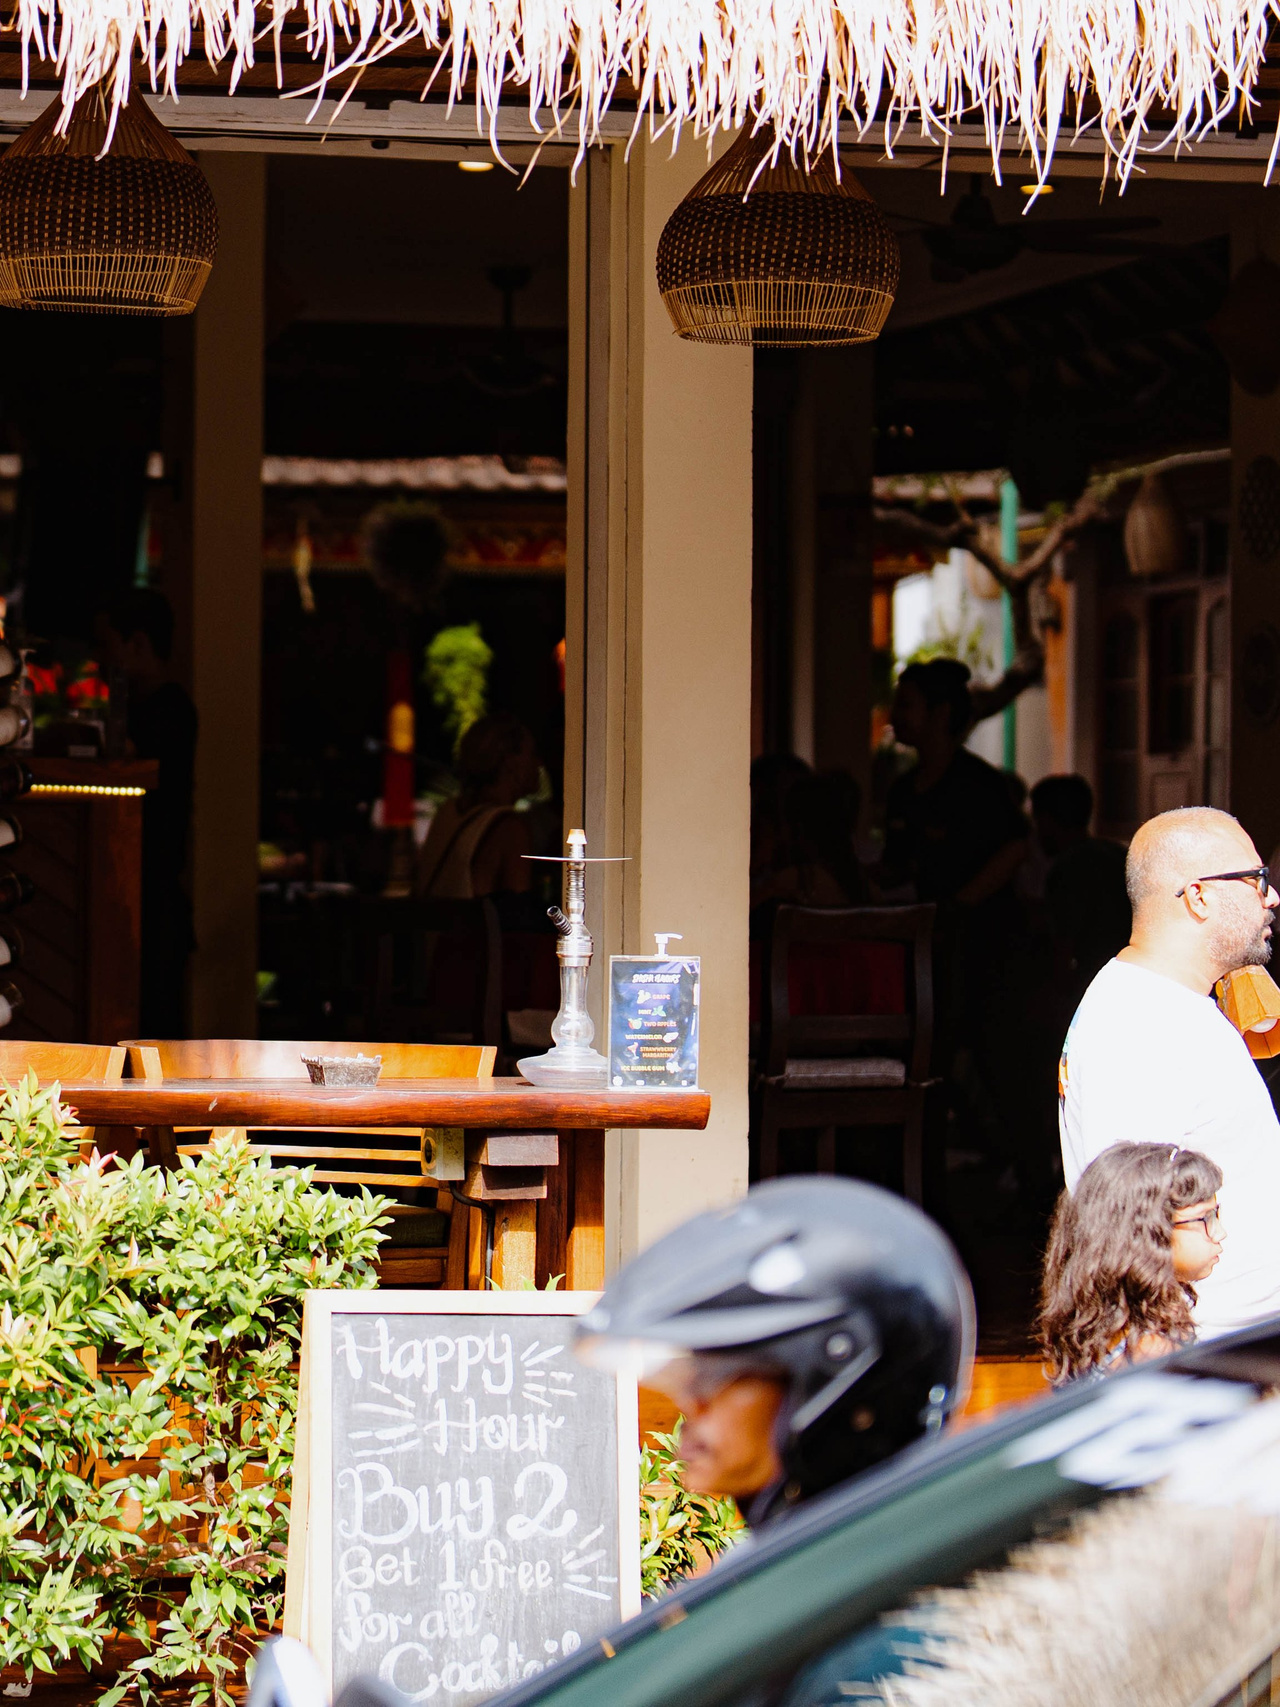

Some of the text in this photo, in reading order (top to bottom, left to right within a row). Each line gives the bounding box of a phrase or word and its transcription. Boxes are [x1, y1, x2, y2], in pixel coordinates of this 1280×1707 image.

[335, 1316, 514, 1395] Happy
[422, 1397, 566, 1456] Hour
[336, 1461, 578, 1545] Buy 2
[336, 1539, 554, 1594] Get 1 free
[337, 1590, 482, 1653] for all
